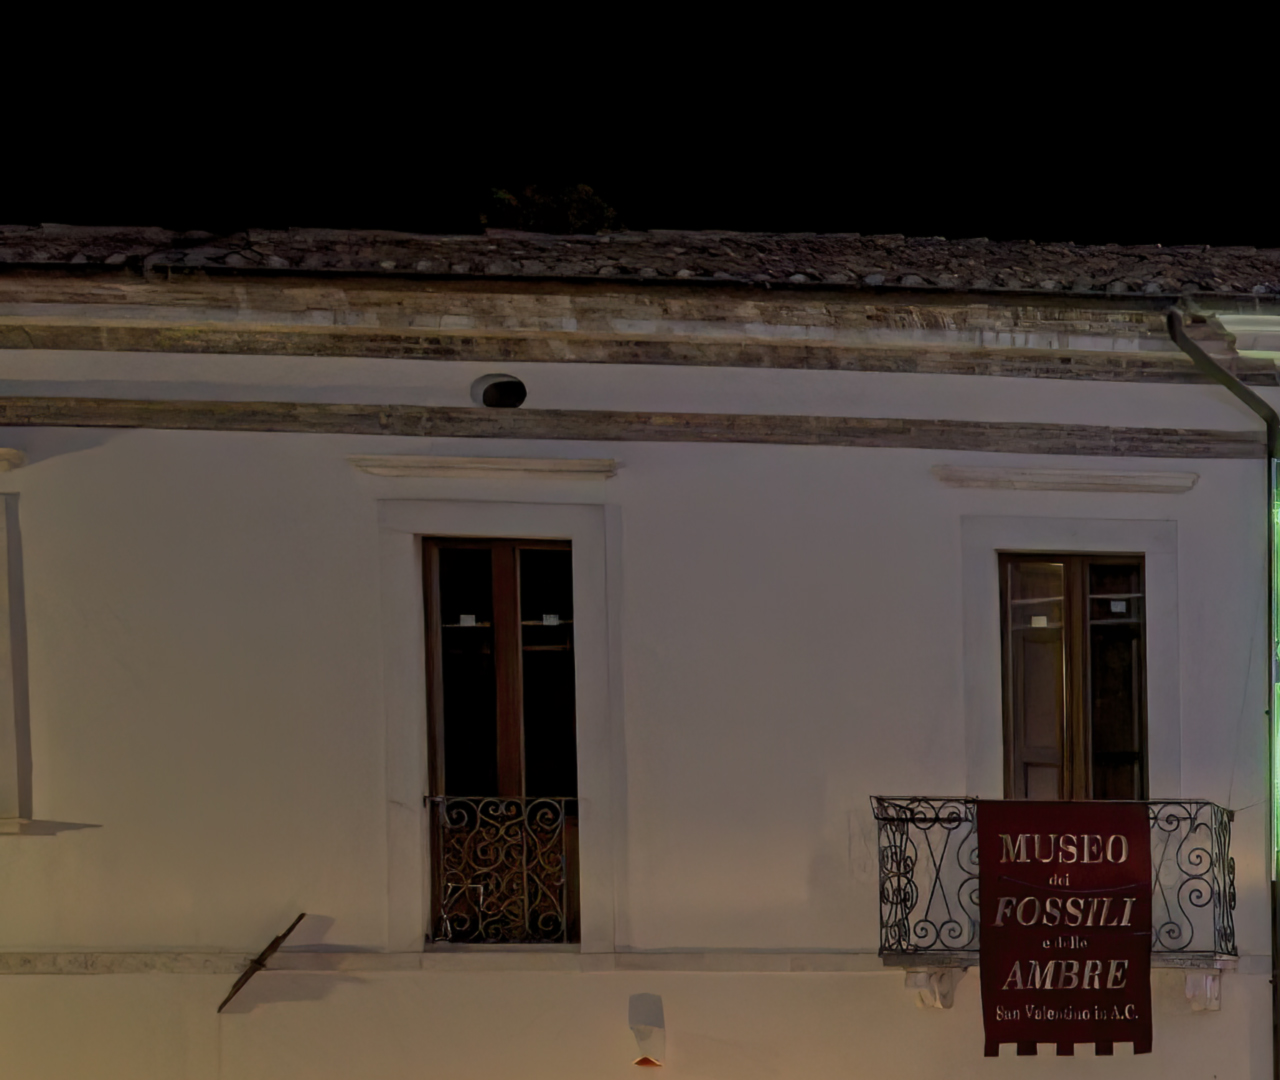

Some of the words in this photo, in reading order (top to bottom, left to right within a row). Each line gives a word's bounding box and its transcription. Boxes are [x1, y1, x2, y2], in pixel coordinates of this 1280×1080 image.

[998, 833, 1130, 864] MUSEO
[1049, 873, 1070, 887] dei
[994, 896, 1137, 927] FOSSILI
[1001, 959, 1130, 990] AMBRE
[995, 1004, 1020, 1021] San
[1025, 1003, 1091, 1021] Valentino
[1110, 1003, 1140, 1020] A.C.
